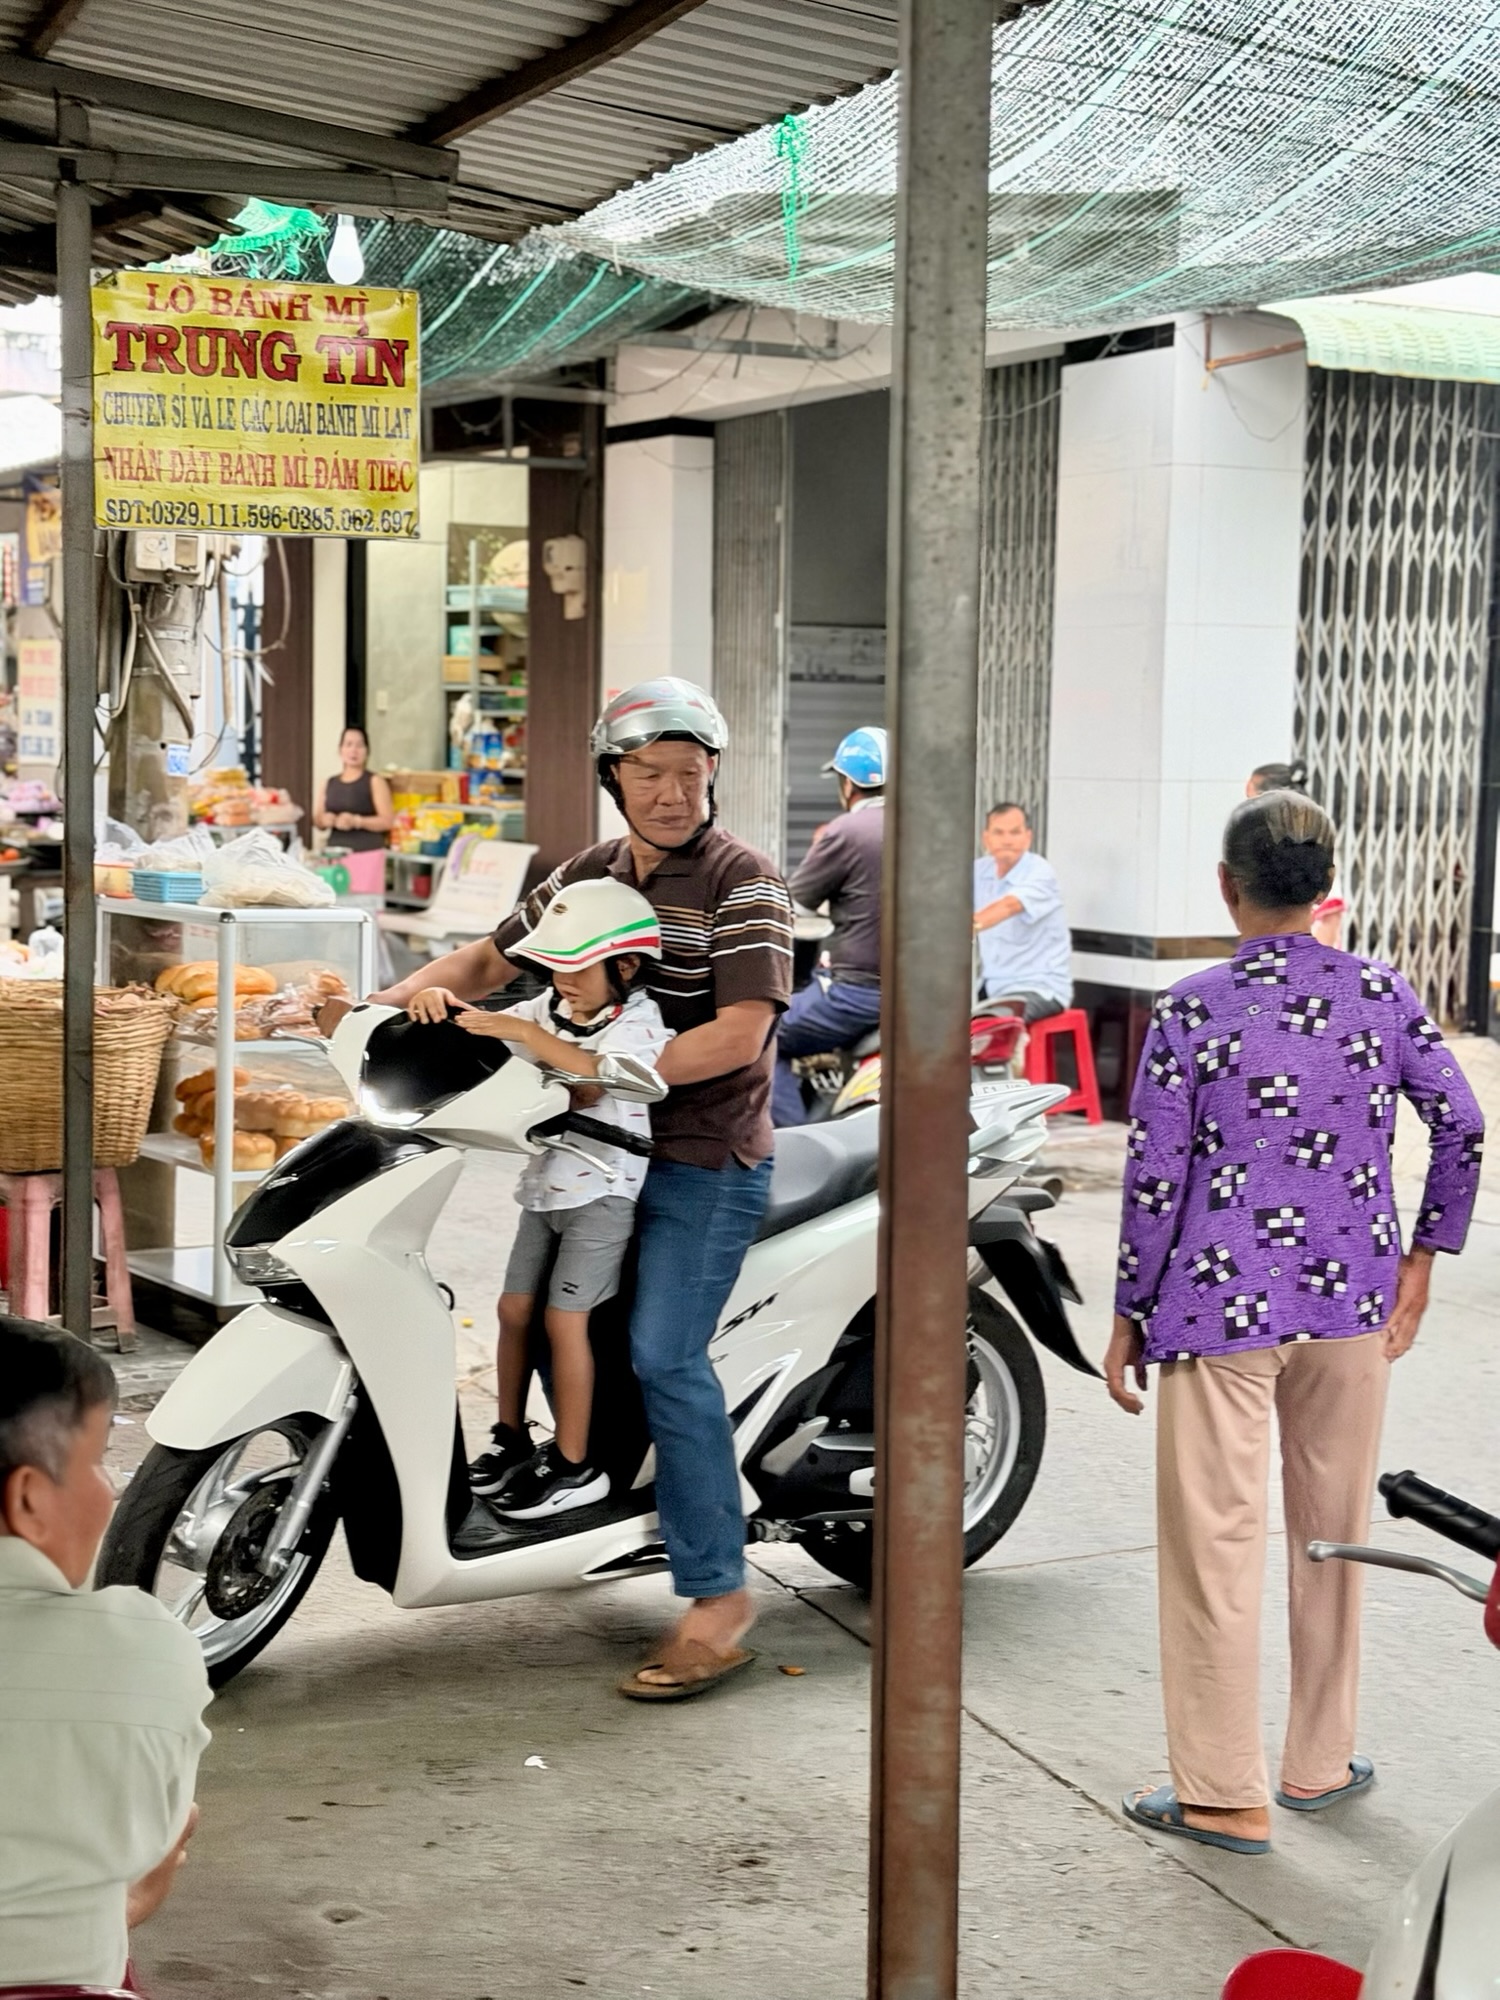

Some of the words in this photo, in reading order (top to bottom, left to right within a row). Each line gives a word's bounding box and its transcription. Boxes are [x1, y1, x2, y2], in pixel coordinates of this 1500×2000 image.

[146, 277, 195, 314] LÒ
[208, 282, 313, 322] BÁNH
[324, 290, 369, 325] MÌ
[103, 320, 302, 382] TRUNG
[315, 325, 410, 388] TÍN
[191, 389, 213, 430] VÀ
[241, 392, 272, 434] CÁC
[316, 396, 358, 437] BÁNH
[361, 398, 381, 438] MÌ
[219, 445, 277, 487] BÁNH
[282, 448, 309, 489] MÌ
[313, 449, 360, 491] ĐÁM
